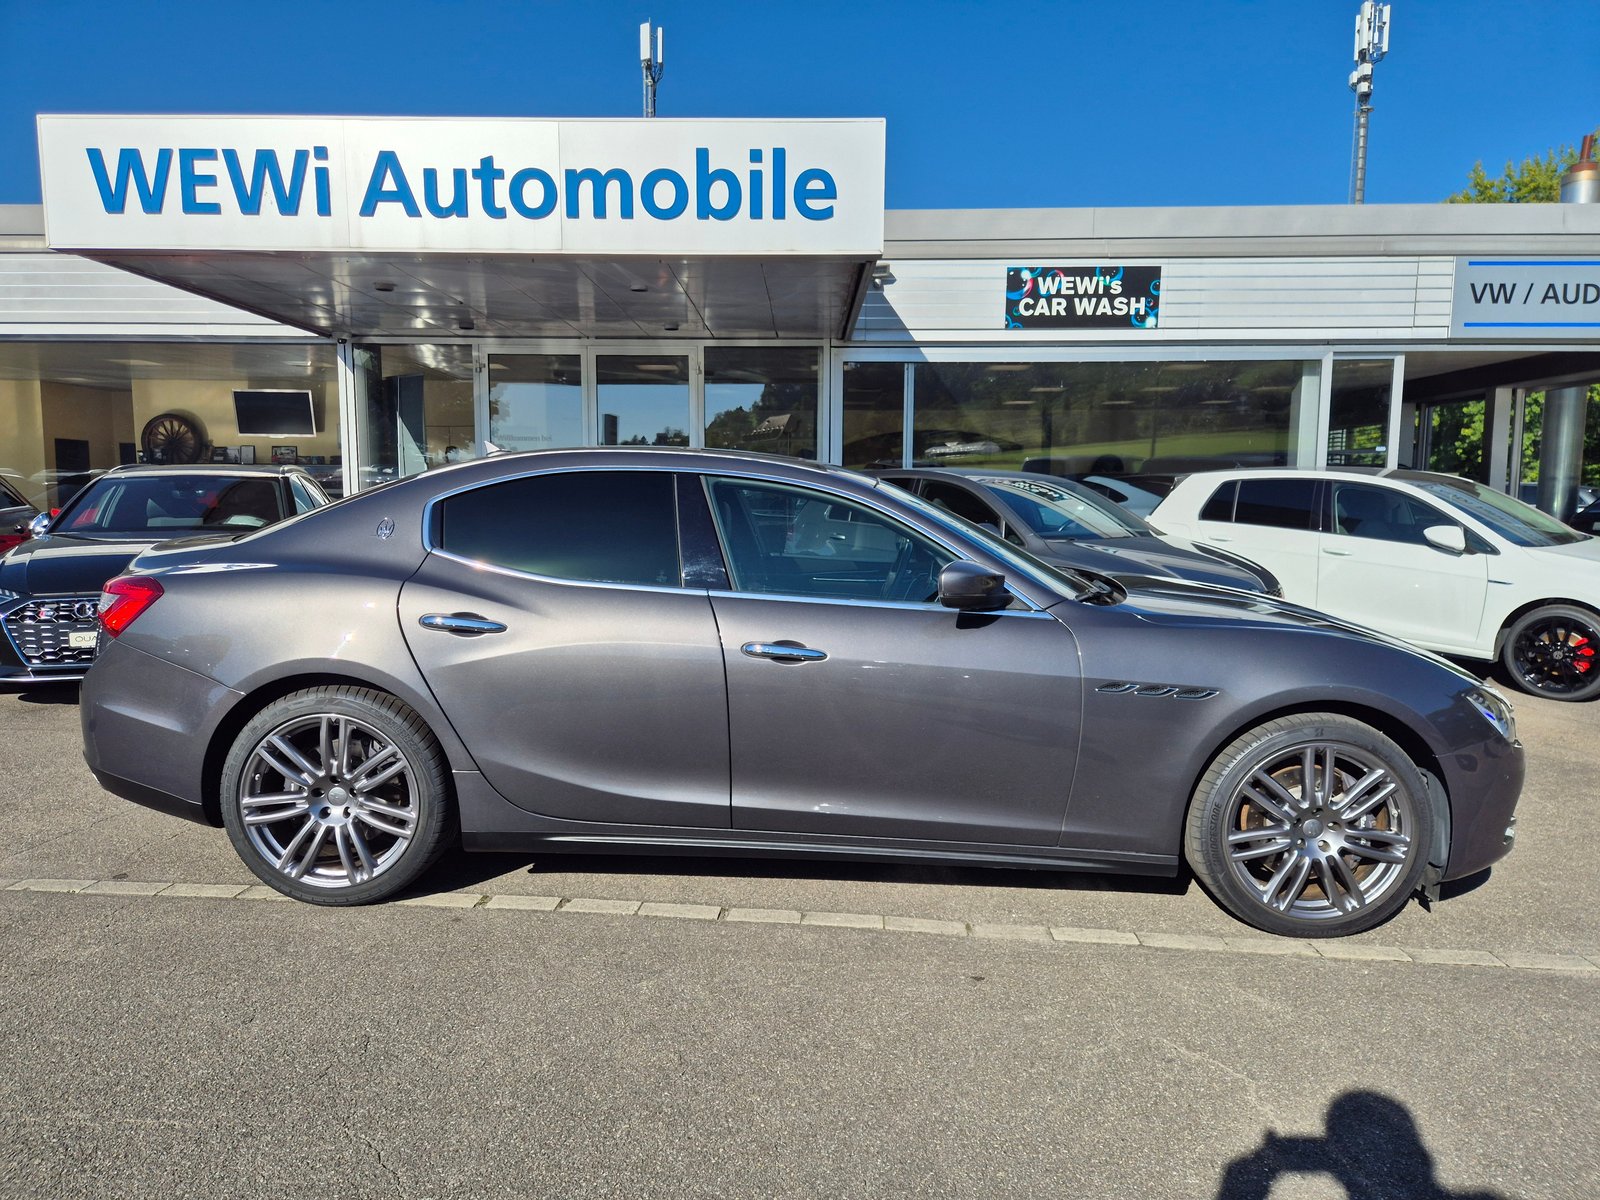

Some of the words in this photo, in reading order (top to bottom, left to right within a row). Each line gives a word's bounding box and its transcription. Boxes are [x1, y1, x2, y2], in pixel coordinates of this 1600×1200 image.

[86, 146, 332, 217] WEWi
[360, 147, 838, 221] Automobile
[1037, 275, 1123, 295] WEWi's
[1470, 282, 1517, 304] VW
[1523, 283, 1534, 304] /
[1541, 283, 1600, 305] AUD
[1018, 297, 1067, 316] CAR
[1073, 297, 1146, 316] WASH
[497, 434, 541, 442] Willkommen
